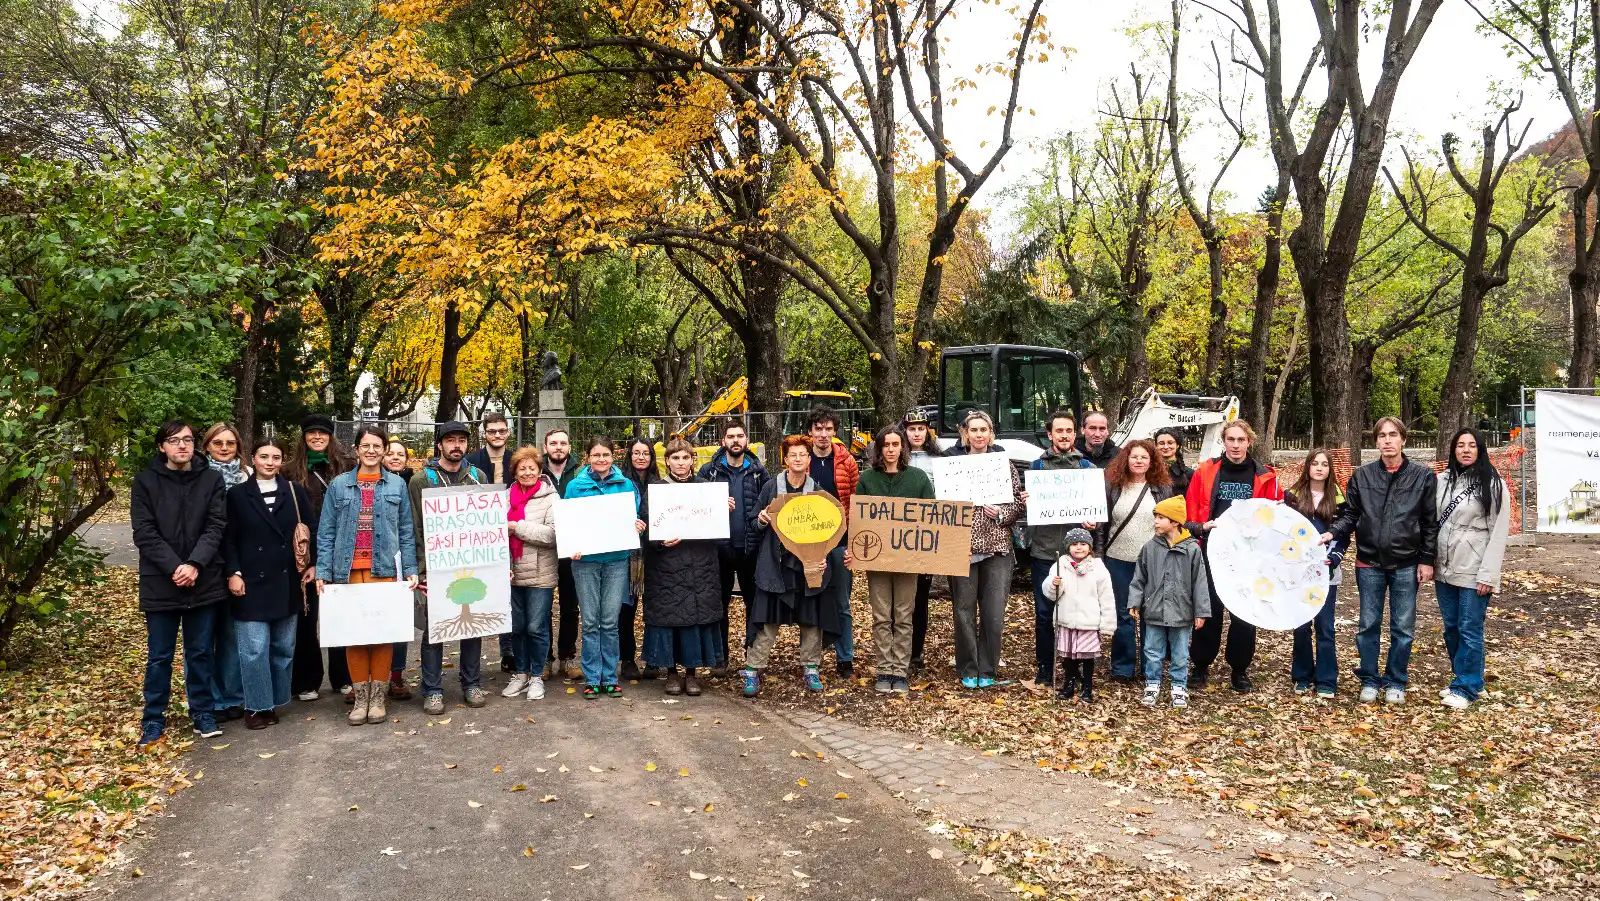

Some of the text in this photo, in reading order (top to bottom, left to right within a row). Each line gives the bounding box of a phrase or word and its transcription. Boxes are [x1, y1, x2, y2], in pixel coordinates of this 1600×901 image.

[1548, 430, 1600, 440] reamenaje
[424, 498, 450, 514] NU
[856, 501, 973, 527] TOALETĂRILE
[1040, 509, 1055, 519] NU
[426, 511, 506, 533] BRAȘOVUL
